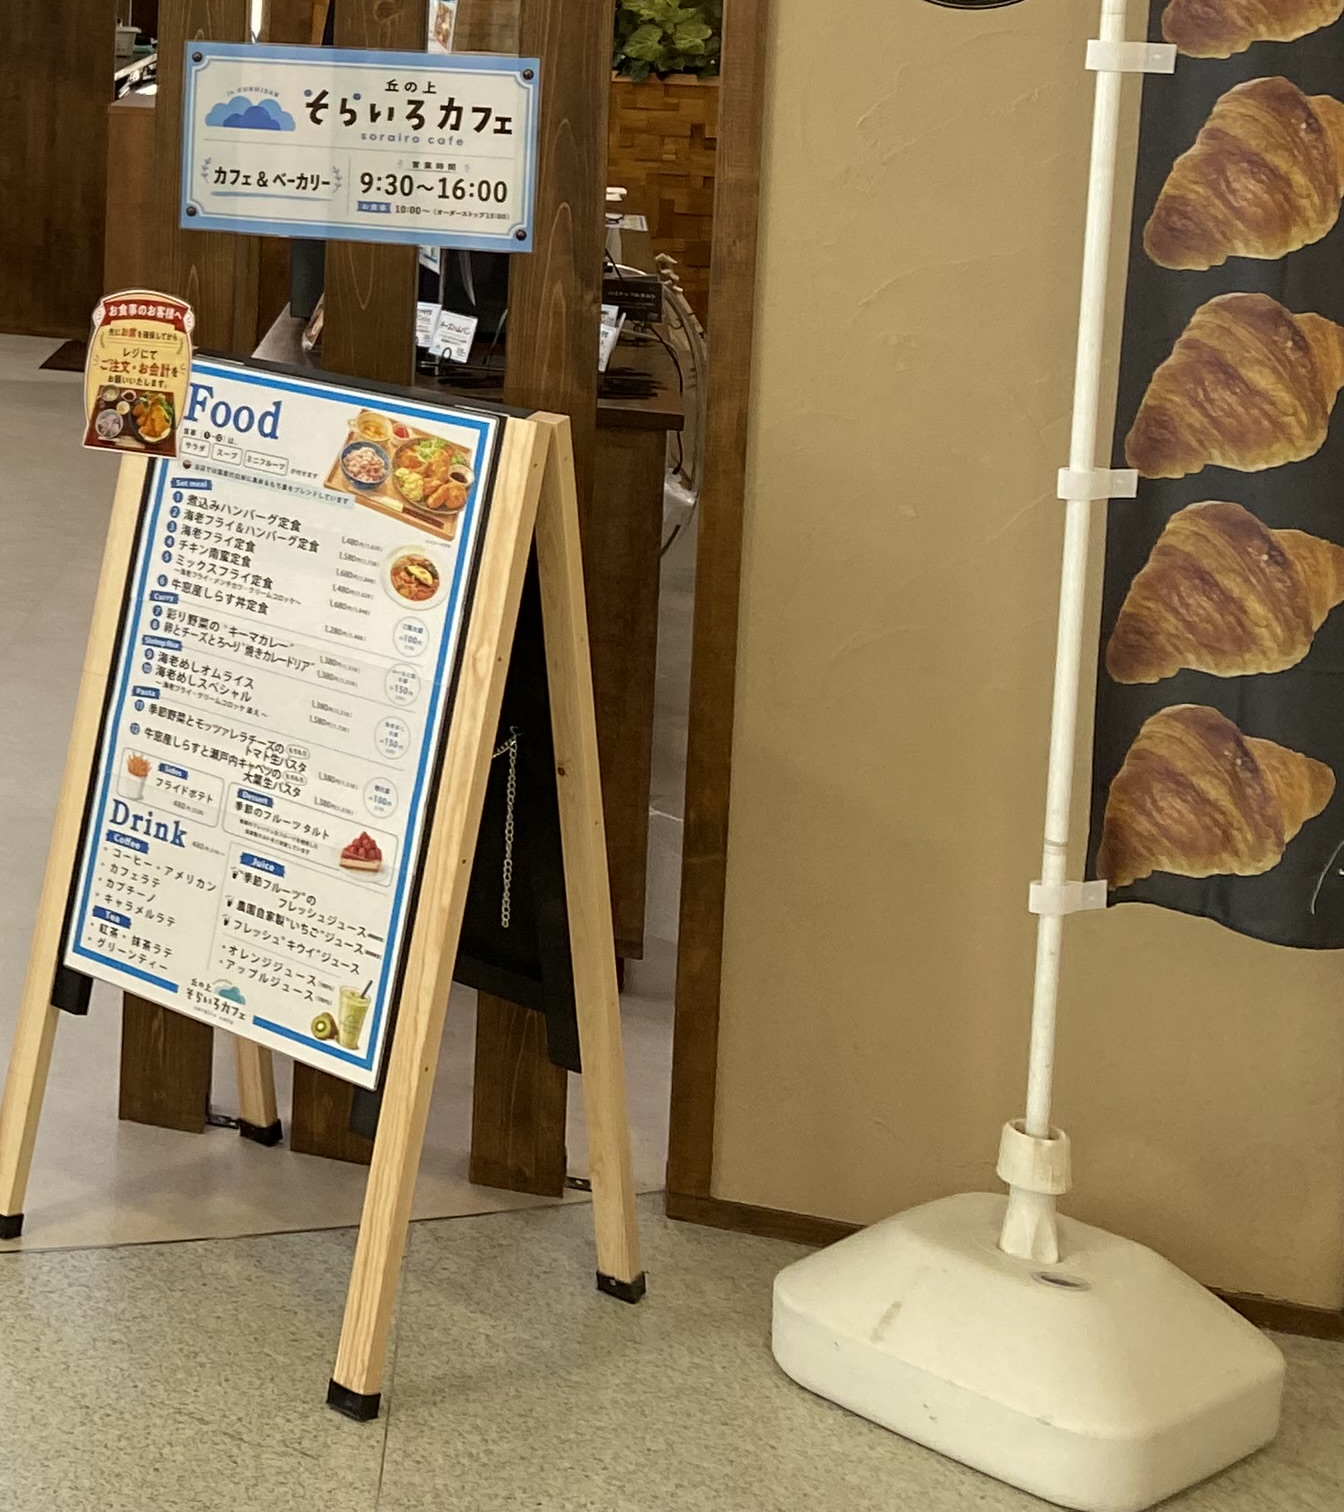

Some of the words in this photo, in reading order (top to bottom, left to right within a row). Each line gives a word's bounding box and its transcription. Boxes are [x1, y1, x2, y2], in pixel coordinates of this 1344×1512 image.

[384, 79, 437, 94] 丘の上
[304, 89, 513, 136] そらいろカフェ
[361, 131, 421, 145] sorairo
[427, 134, 464, 147] cafe
[412, 161, 456, 171] 営業時間
[109, 304, 182, 320] お食事のお客様へ
[123, 348, 158, 360] レジにて
[100, 359, 178, 377] ご注文・お会計を
[184, 383, 283, 440] Food
[185, 442, 206, 452] サラダ
[217, 448, 238, 459] スープ
[247, 455, 286, 470] ミニフルーツ
[186, 493, 302, 533] 煮込みハンバーグ定食
[181, 524, 256, 554] 海老フライ定食
[178, 539, 252, 568] チキン南蛮定食
[176, 554, 274, 590] ミックスフライ定食
[158, 651, 255, 690] 海老めしオムライス
[136, 688, 156, 697] Pasta
[155, 665, 252, 703] 海老めしスペシャル
[246, 746, 307, 773] トマト生パスタ
[156, 778, 213, 803] フライドポテト
[243, 772, 301, 798] 大葉生パスタ
[109, 799, 187, 848] Drink
[114, 833, 141, 849] Coffee
[110, 863, 160, 888] カフェラテ
[251, 857, 276, 871] Juice
[105, 894, 176, 927] キャラメルラテ
[106, 911, 121, 923] Tea
[278, 898, 367, 938] フレッシュジュース
[97, 938, 168, 971] グリーンティー
[229, 945, 316, 987] オレンジジュース
[191, 977, 212, 993] 丘の上
[223, 960, 313, 1002] アップルジュース
[186, 987, 246, 1021] そらいろカフェ
